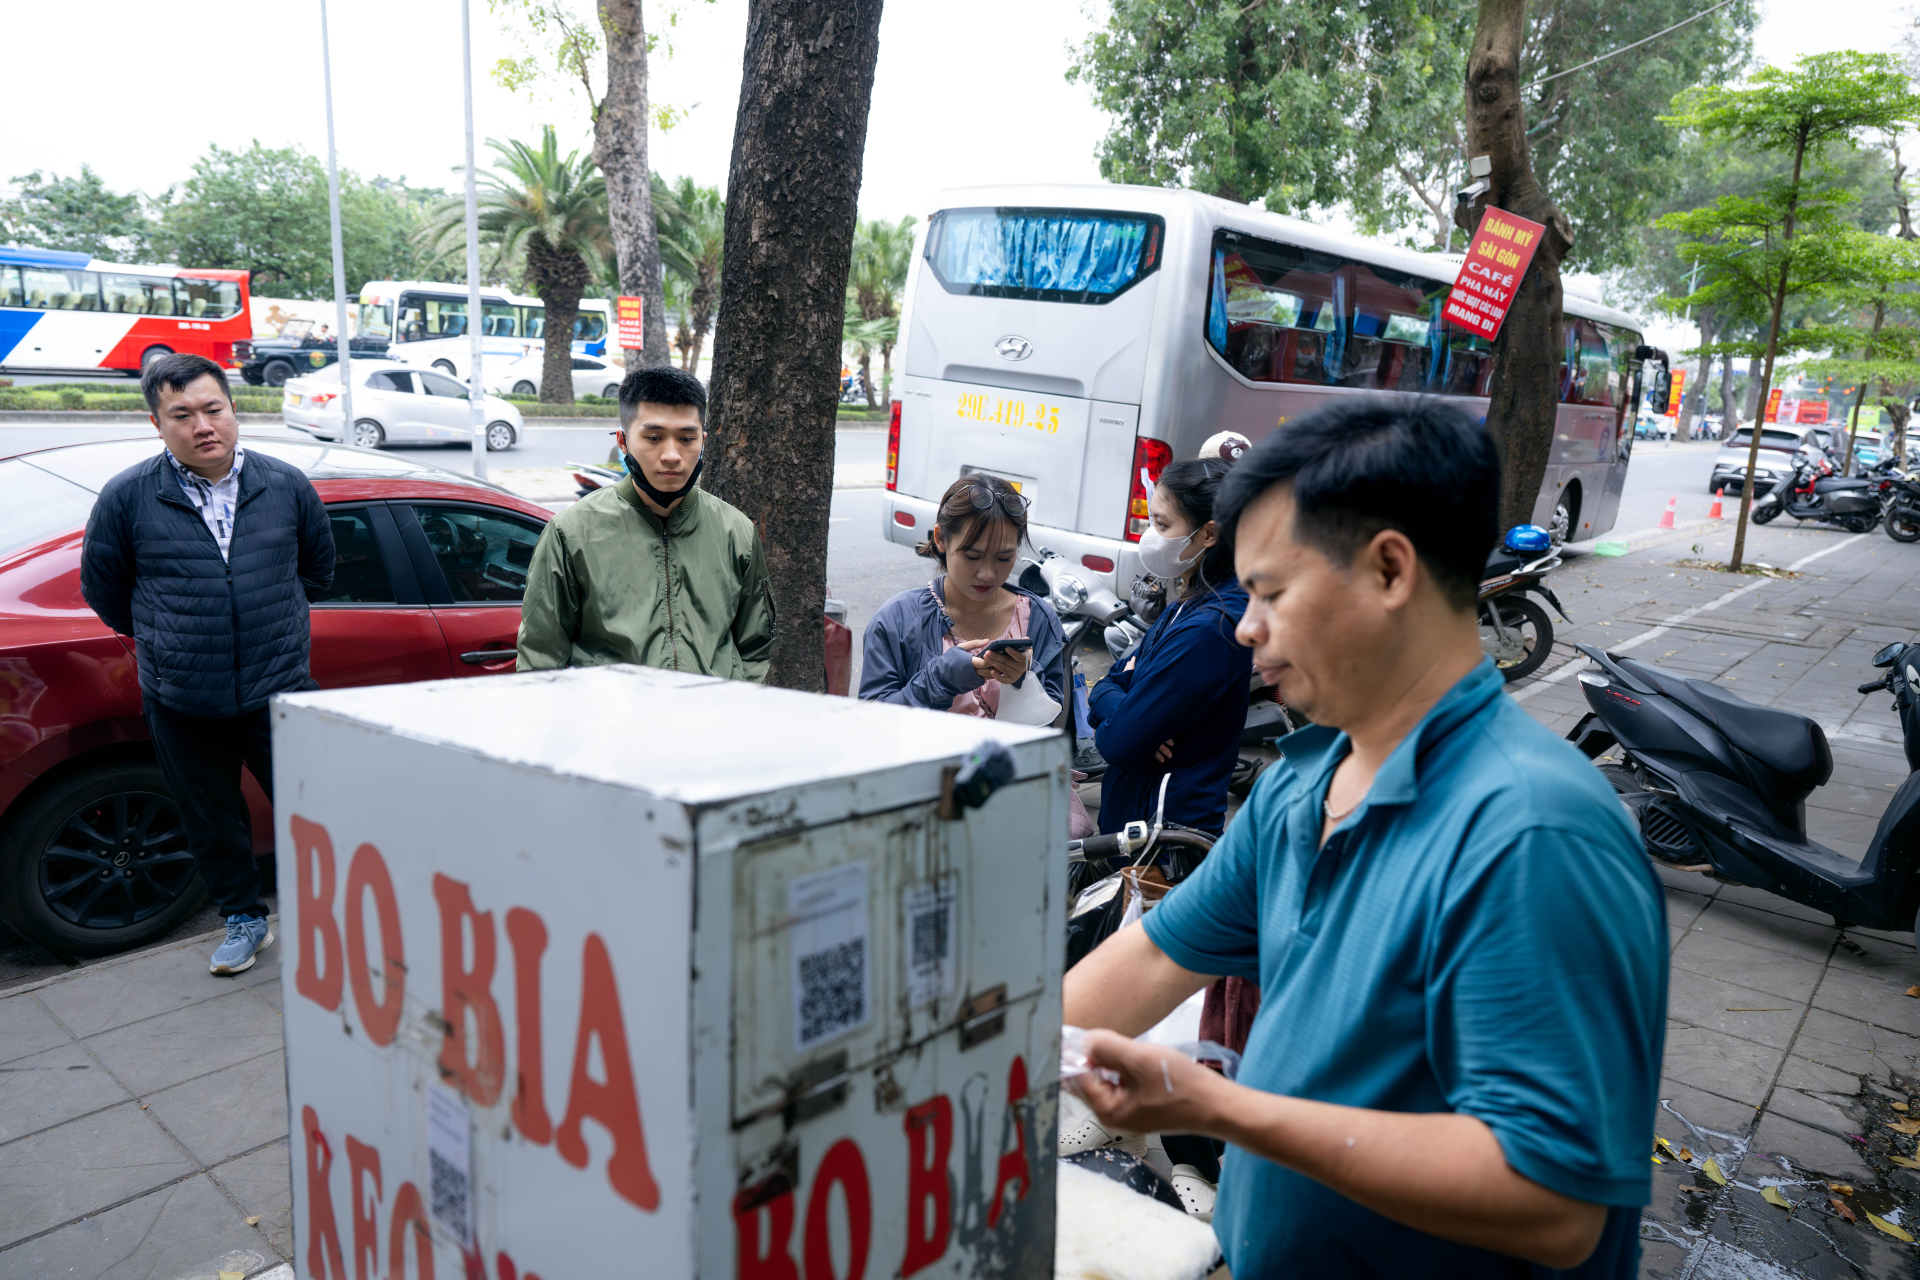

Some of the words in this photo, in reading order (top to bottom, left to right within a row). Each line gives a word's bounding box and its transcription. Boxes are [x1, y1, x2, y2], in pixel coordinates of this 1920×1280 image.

[1484, 217, 1516, 242] BÁNH
[1513, 229, 1534, 248] MỲ
[1478, 241, 1498, 260] SÀI
[1496, 248, 1521, 269] GÒN
[1460, 274, 1482, 293] PHA
[1481, 284, 1508, 303] MÁY
[1467, 262, 1514, 288] CAFÉ
[1447, 302, 1482, 326] MANG
[1481, 318, 1496, 332] ĐI
[1464, 293, 1482, 310] NGỌT
[1478, 300, 1492, 314] CÁC
[1489, 304, 1505, 321] LOẠI
[432, 871, 662, 1216] BIA
